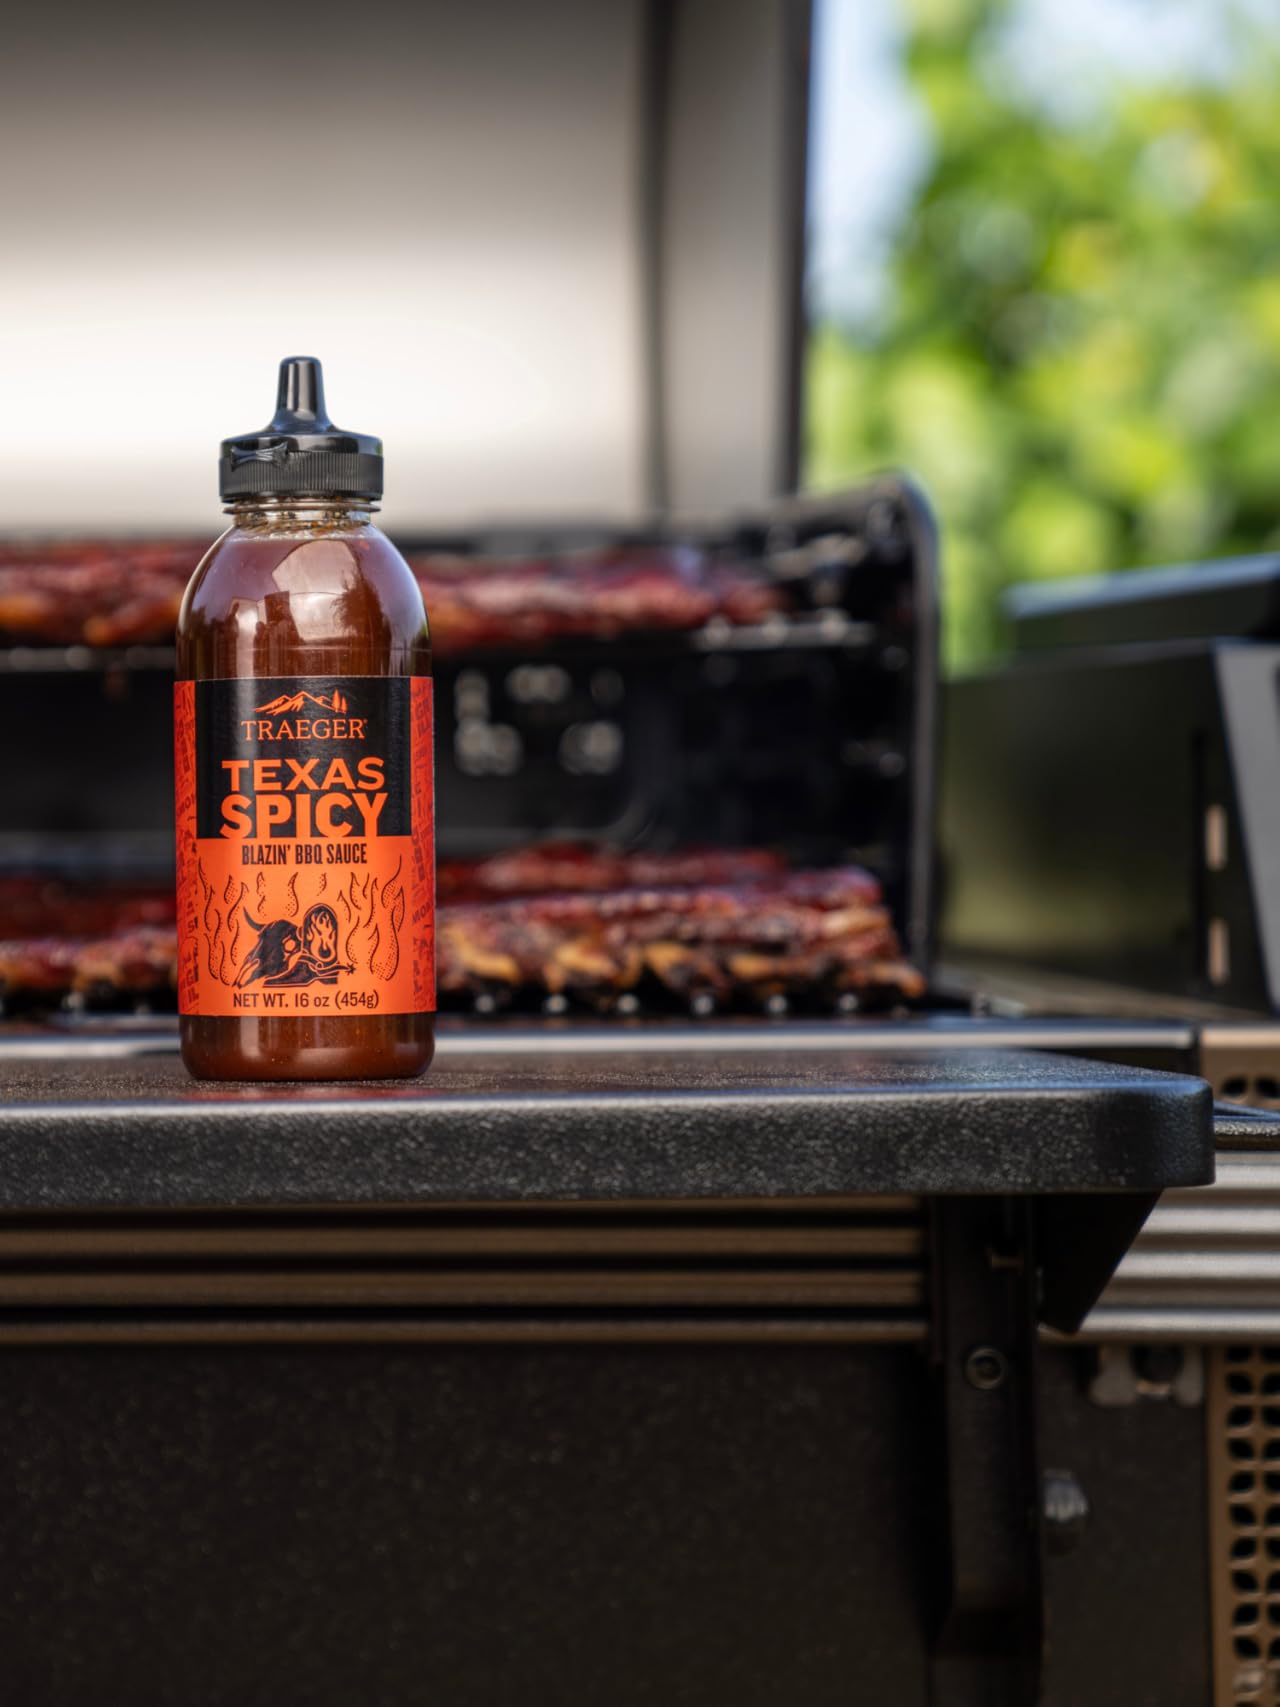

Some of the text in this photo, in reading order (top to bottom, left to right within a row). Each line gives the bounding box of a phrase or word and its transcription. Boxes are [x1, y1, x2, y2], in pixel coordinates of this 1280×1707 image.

[241, 719, 366, 741] TRAEGER
[221, 757, 385, 791] TEXAS
[220, 792, 388, 839] SPICY
[241, 843, 368, 865] BLAZIN' BBQ SAUCE
[233, 990, 380, 1010] NET WT. 16 oz (454g)
